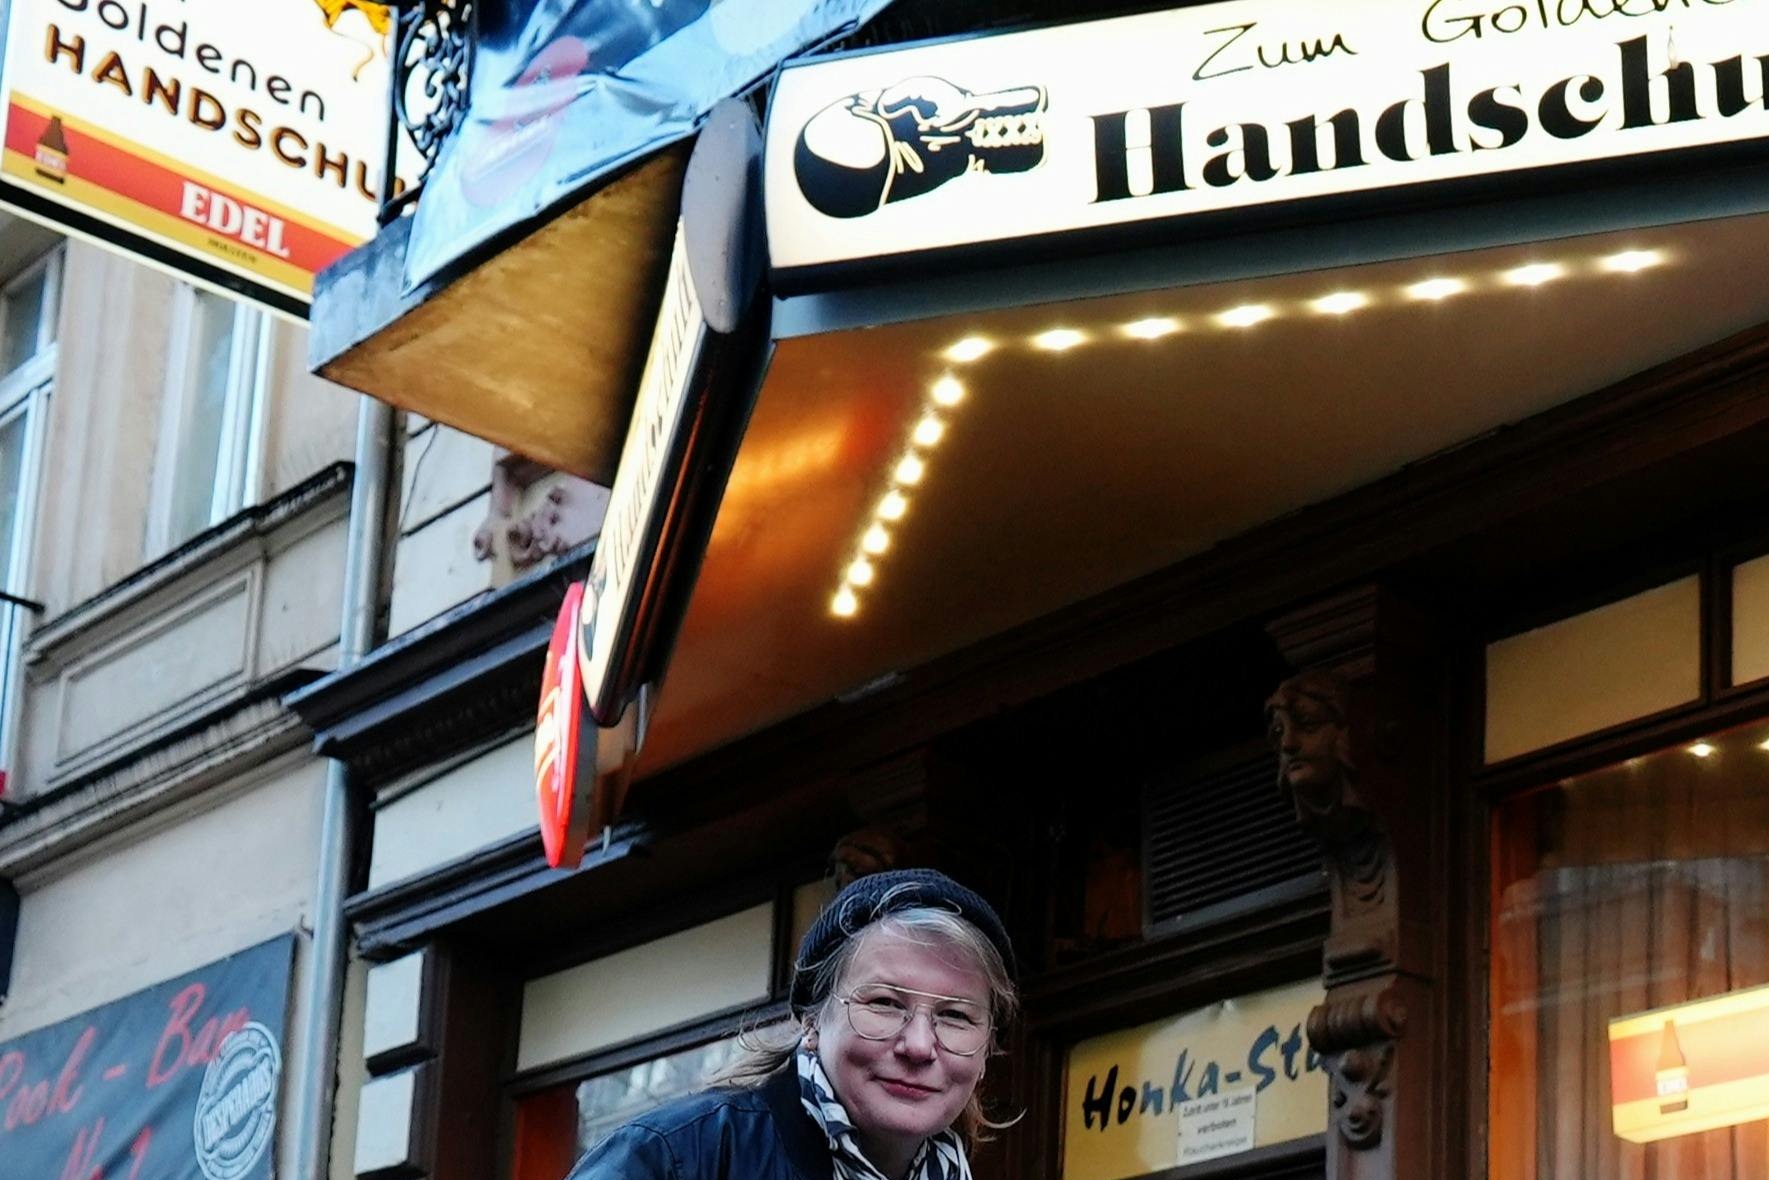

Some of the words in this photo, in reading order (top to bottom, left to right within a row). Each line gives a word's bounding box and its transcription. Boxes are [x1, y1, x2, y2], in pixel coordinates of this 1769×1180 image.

[57, 0, 325, 121] oldenen
[1191, 21, 1359, 80] Zum
[180, 181, 291, 259] EDEL
